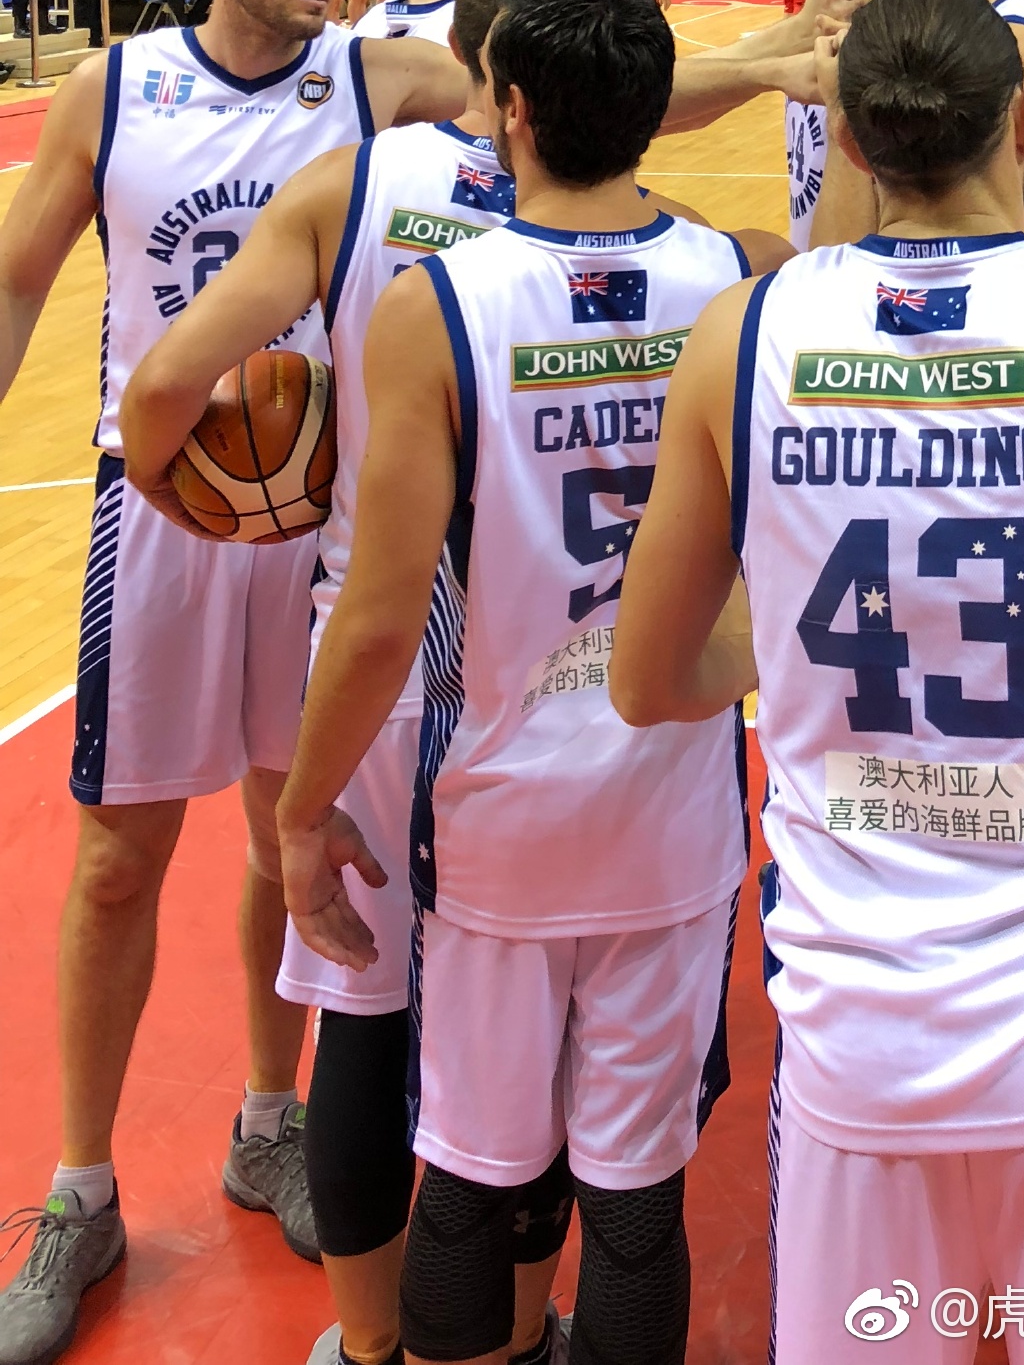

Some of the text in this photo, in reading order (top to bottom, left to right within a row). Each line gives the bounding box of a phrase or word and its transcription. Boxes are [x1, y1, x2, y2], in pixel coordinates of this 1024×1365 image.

[574, 233, 637, 248] AUSTRALIA
[893, 241, 961, 258] AUSTRALIA
[525, 347, 608, 377] JOHN
[805, 357, 1016, 393] JOHN WEST
[562, 465, 656, 624] 5
[520, 662, 608, 714] 喜爱的海
[858, 755, 1015, 800] 澳大利亚人
